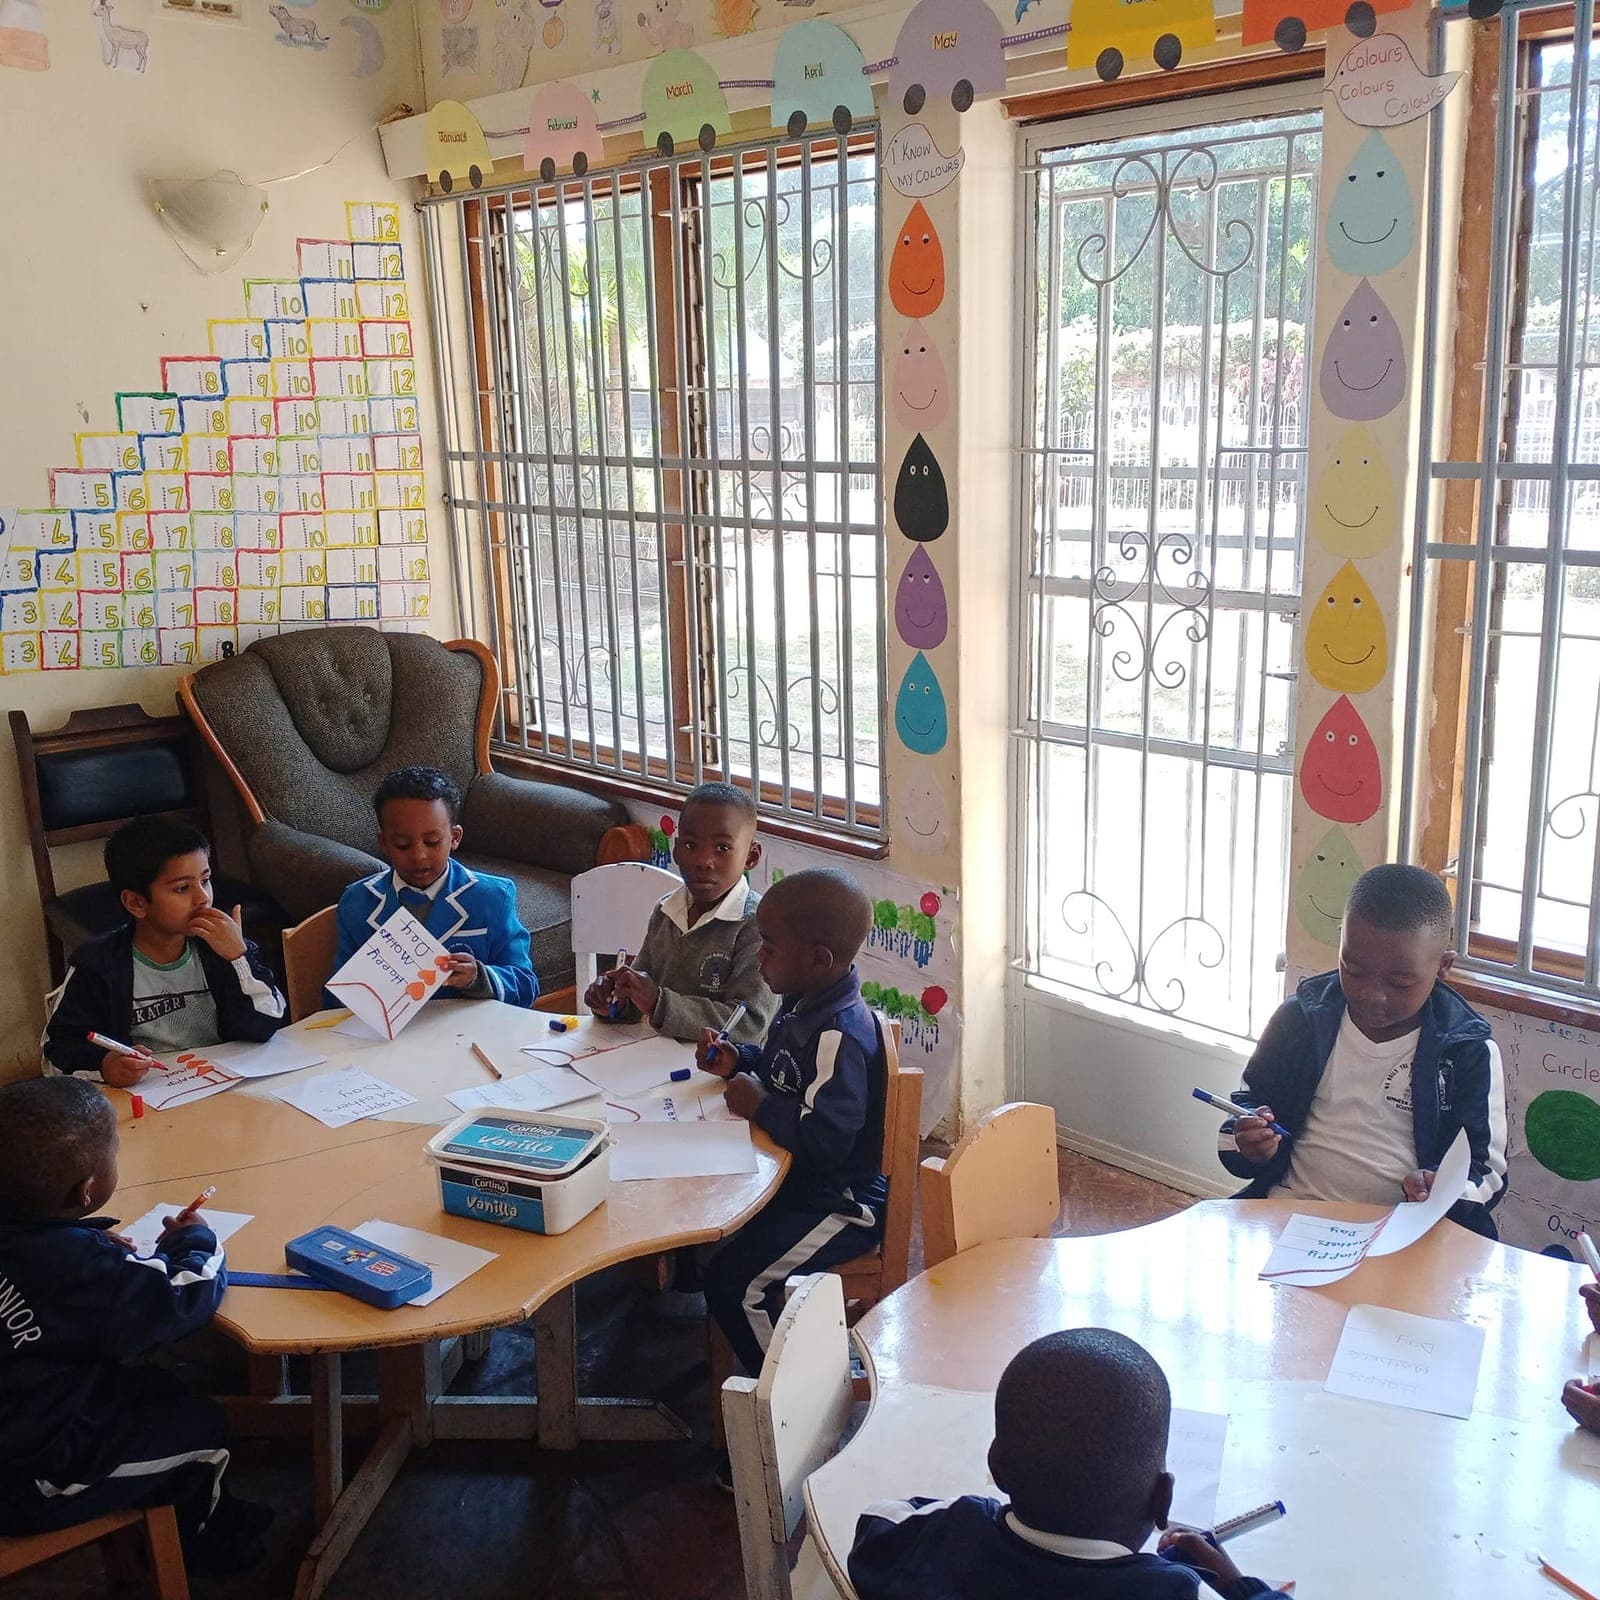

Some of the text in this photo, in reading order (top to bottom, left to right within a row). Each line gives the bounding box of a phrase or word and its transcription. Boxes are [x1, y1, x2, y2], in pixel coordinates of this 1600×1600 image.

[933, 31, 958, 49] May
[804, 62, 824, 79] April
[1346, 46, 1402, 72] Colours
[666, 81, 694, 99] March
[1340, 80, 1394, 101] Colours
[1384, 85, 1445, 118] Colours
[547, 116, 578, 131] February
[438, 131, 468, 143] January
[902, 142, 931, 160] KNOW
[897, 158, 960, 187] MY COLOURS
[378, 214, 396, 238] 12
[338, 254, 400, 278] 11 12
[281, 294, 405, 318] 10 11 12
[251, 333, 409, 356] 9 10 11 12
[204, 369, 412, 396] 8 9 10 11 12
[159, 407, 415, 435] 7 8 9 10 11 12
[122, 446, 420, 472] 6 7 8 9 10 11 12
[93, 483, 421, 511] 5 6 7 8 9 10 11 12
[51, 518, 425, 551] 4 5 6 7 8 9 10 11 12
[16, 557, 426, 589] 3 4 5 6 7 8 9 10 11 12
[21, 595, 428, 629] 3 4 5 6 7 8 9 10 11 12
[20, 640, 234, 666] 3 4 5 6 7 8
[401, 919, 431, 957] Day
[1542, 1053, 1600, 1083] Circle
[338, 1083, 382, 1098] Day
[352, 1095, 410, 1115] Happy
[478, 1135, 554, 1153] Vanilla
[466, 1195, 518, 1217] Vanilla
[0, 1278, 42, 1349] NIOR
